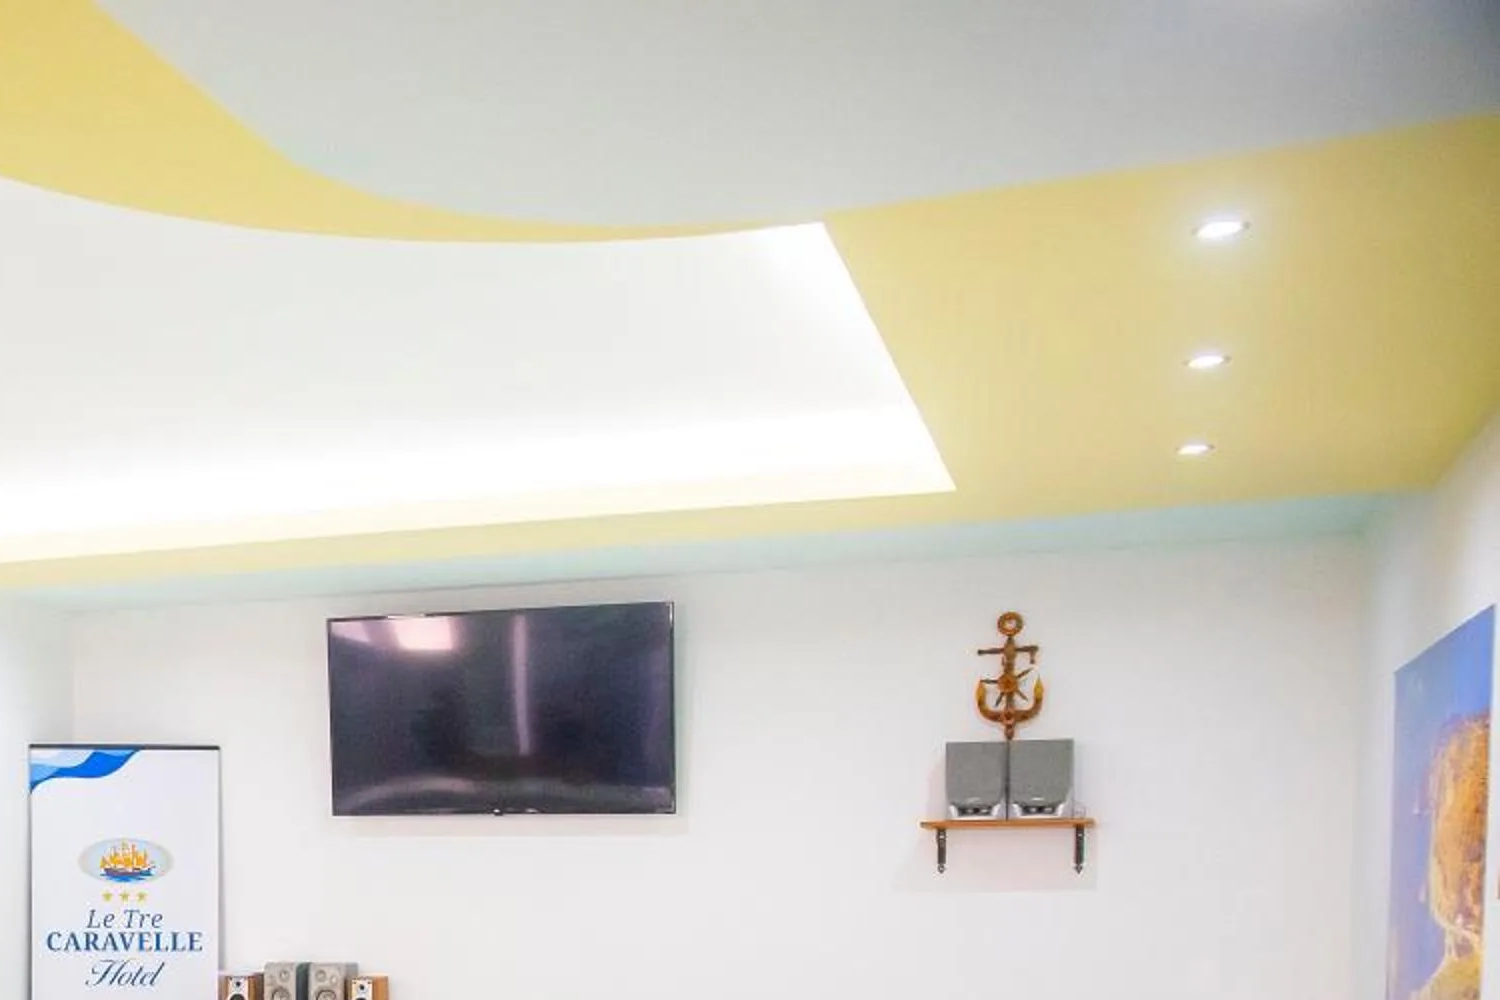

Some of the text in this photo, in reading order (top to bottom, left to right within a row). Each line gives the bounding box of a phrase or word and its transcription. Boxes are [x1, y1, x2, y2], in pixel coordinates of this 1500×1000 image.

[86, 908, 163, 929] Le Tre
[46, 931, 204, 952] CARAVELLE
[84, 957, 166, 987] Hotel
